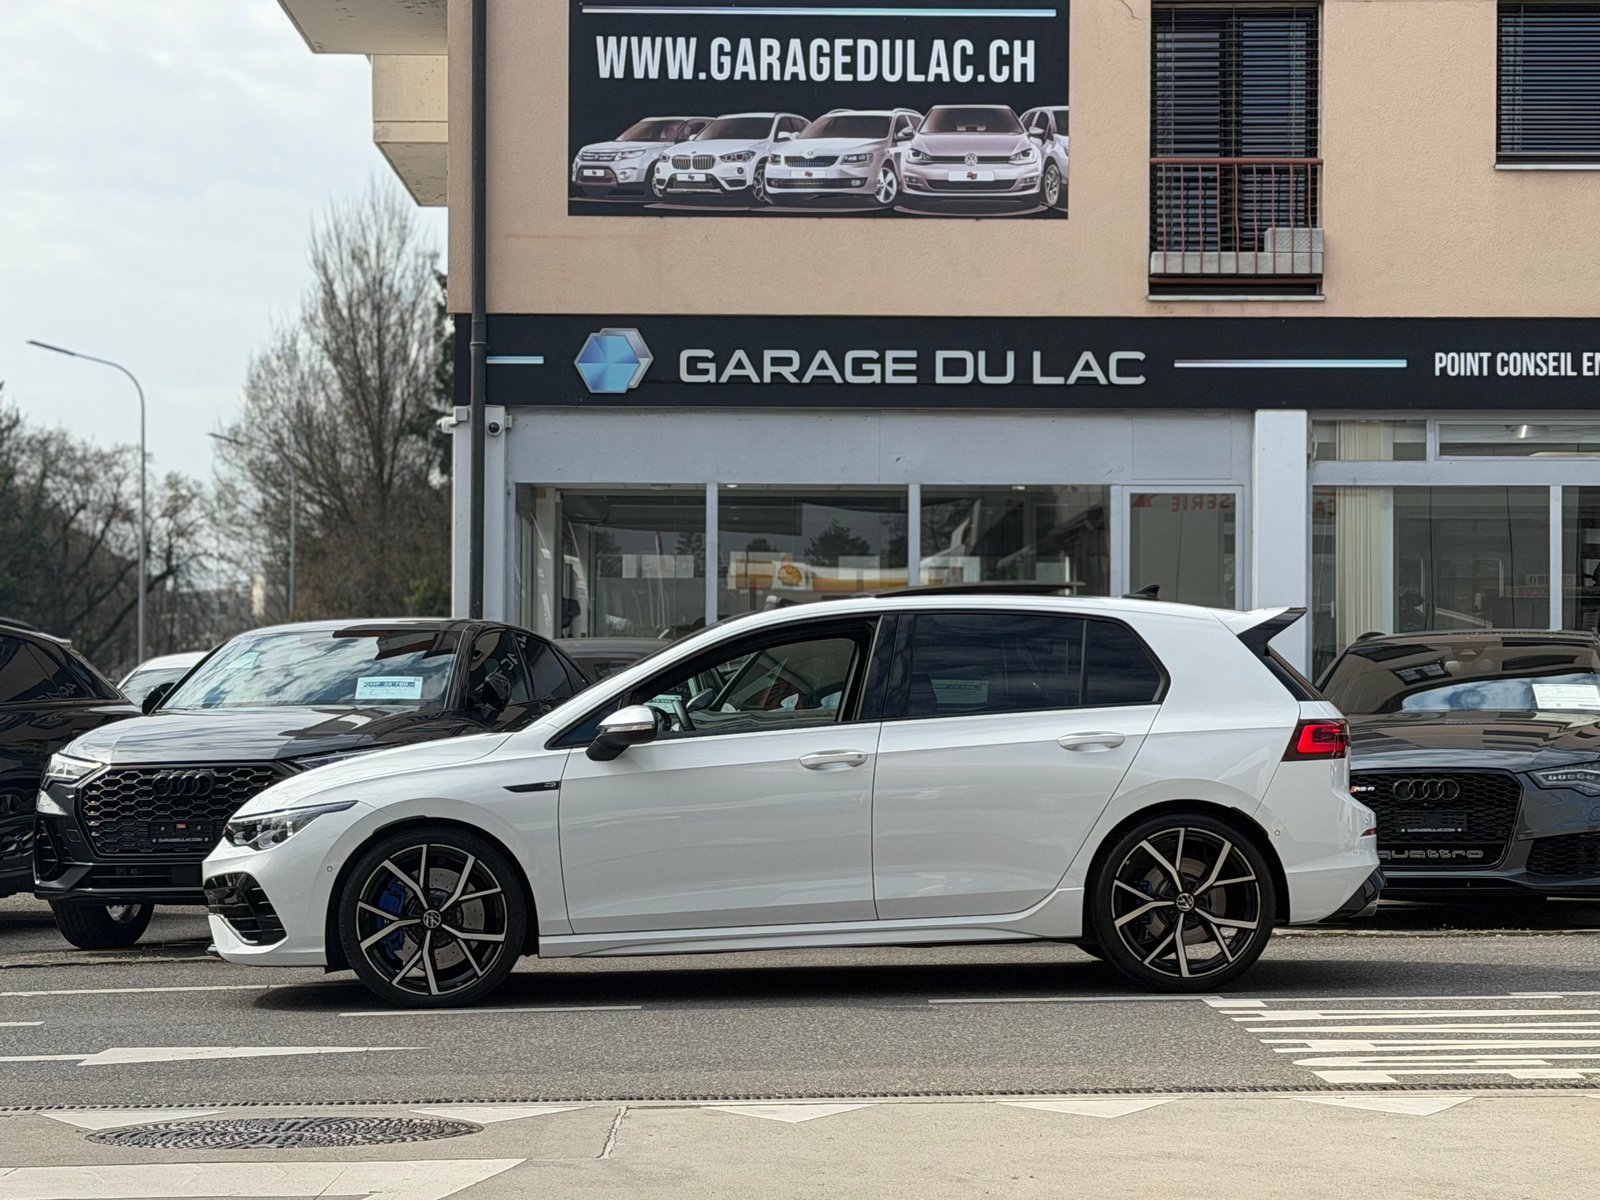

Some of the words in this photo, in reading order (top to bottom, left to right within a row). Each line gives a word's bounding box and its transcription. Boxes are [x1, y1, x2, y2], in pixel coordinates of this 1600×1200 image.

[595, 35, 1036, 83] WWW.GARAGEDULAC.CH
[679, 348, 918, 385] GARAGE
[935, 349, 1015, 385] DU
[1032, 350, 1147, 386] LAC
[1434, 352, 1492, 377] POINT
[1496, 352, 1578, 377] CONSEIL
[1378, 849, 1484, 860] quattro
